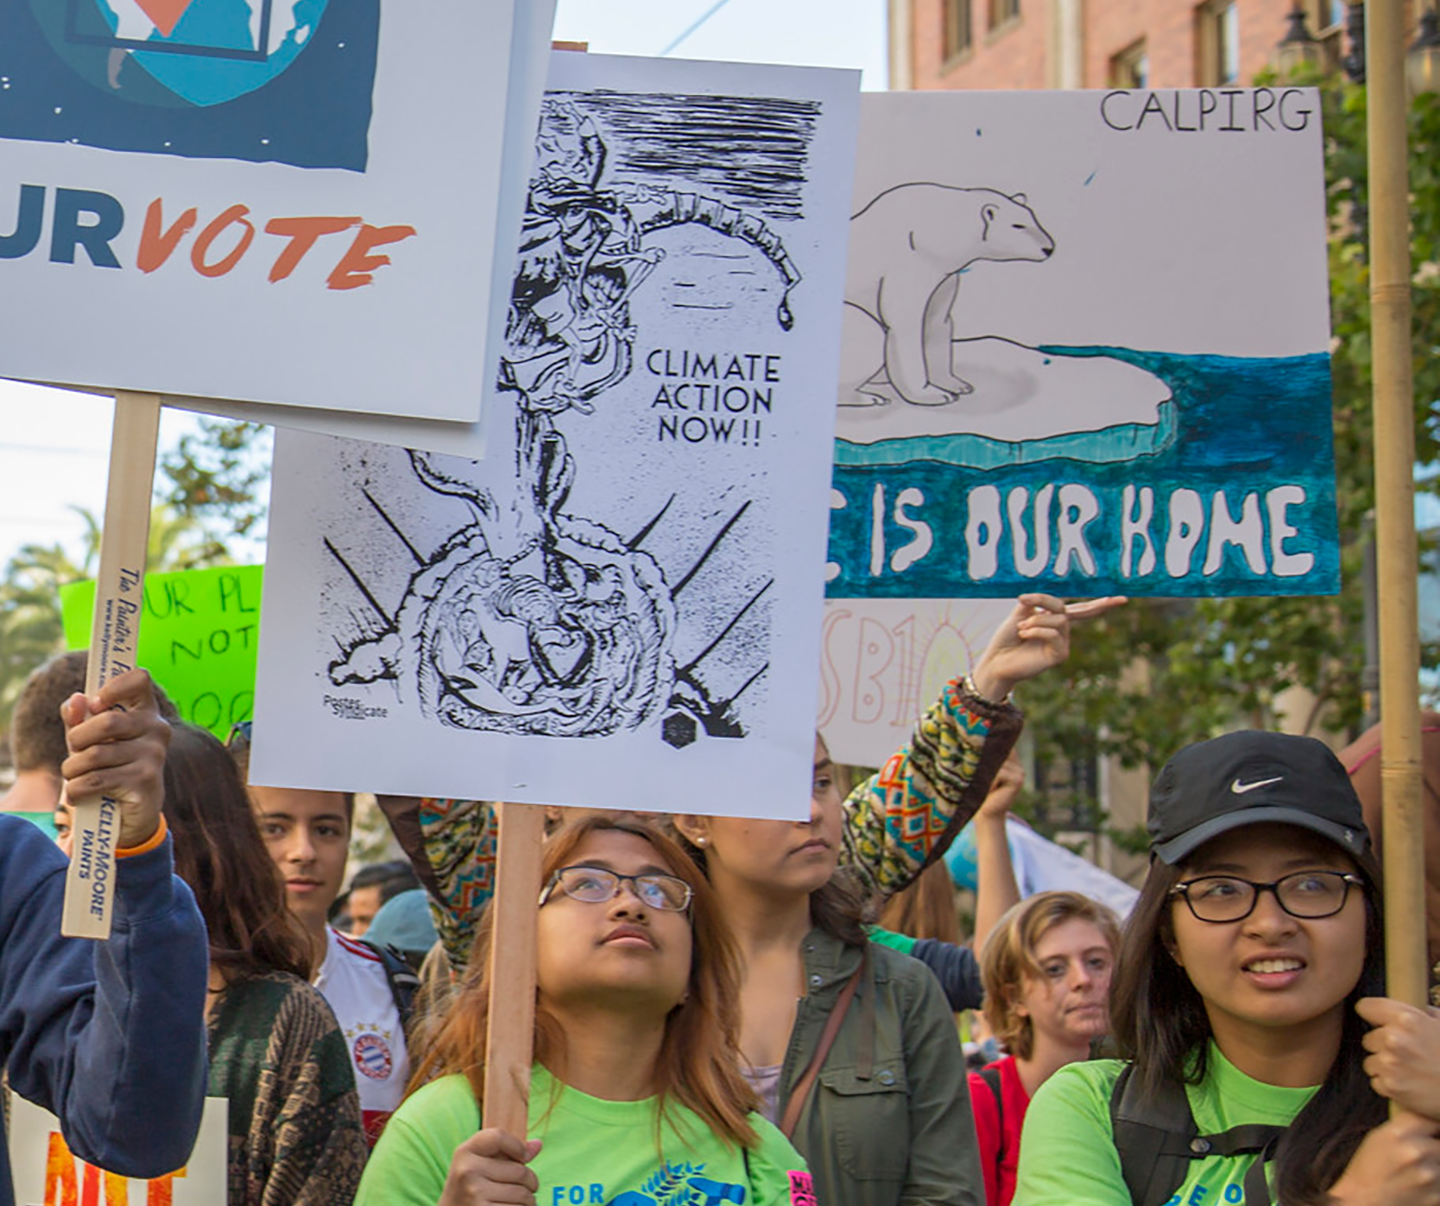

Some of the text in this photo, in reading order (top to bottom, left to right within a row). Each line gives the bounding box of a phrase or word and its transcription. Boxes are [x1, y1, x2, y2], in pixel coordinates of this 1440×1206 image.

[1101, 88, 1312, 131] CALPIRG
[647, 349, 781, 382] CLIMATE
[651, 384, 772, 414] ACTION
[659, 416, 760, 447] NOW!!
[870, 482, 933, 577] IS
[964, 483, 1100, 581] OUR
[1120, 482, 1315, 580] HOME
[142, 573, 257, 619] UR PL
[552, 1183, 605, 1206] FOR
